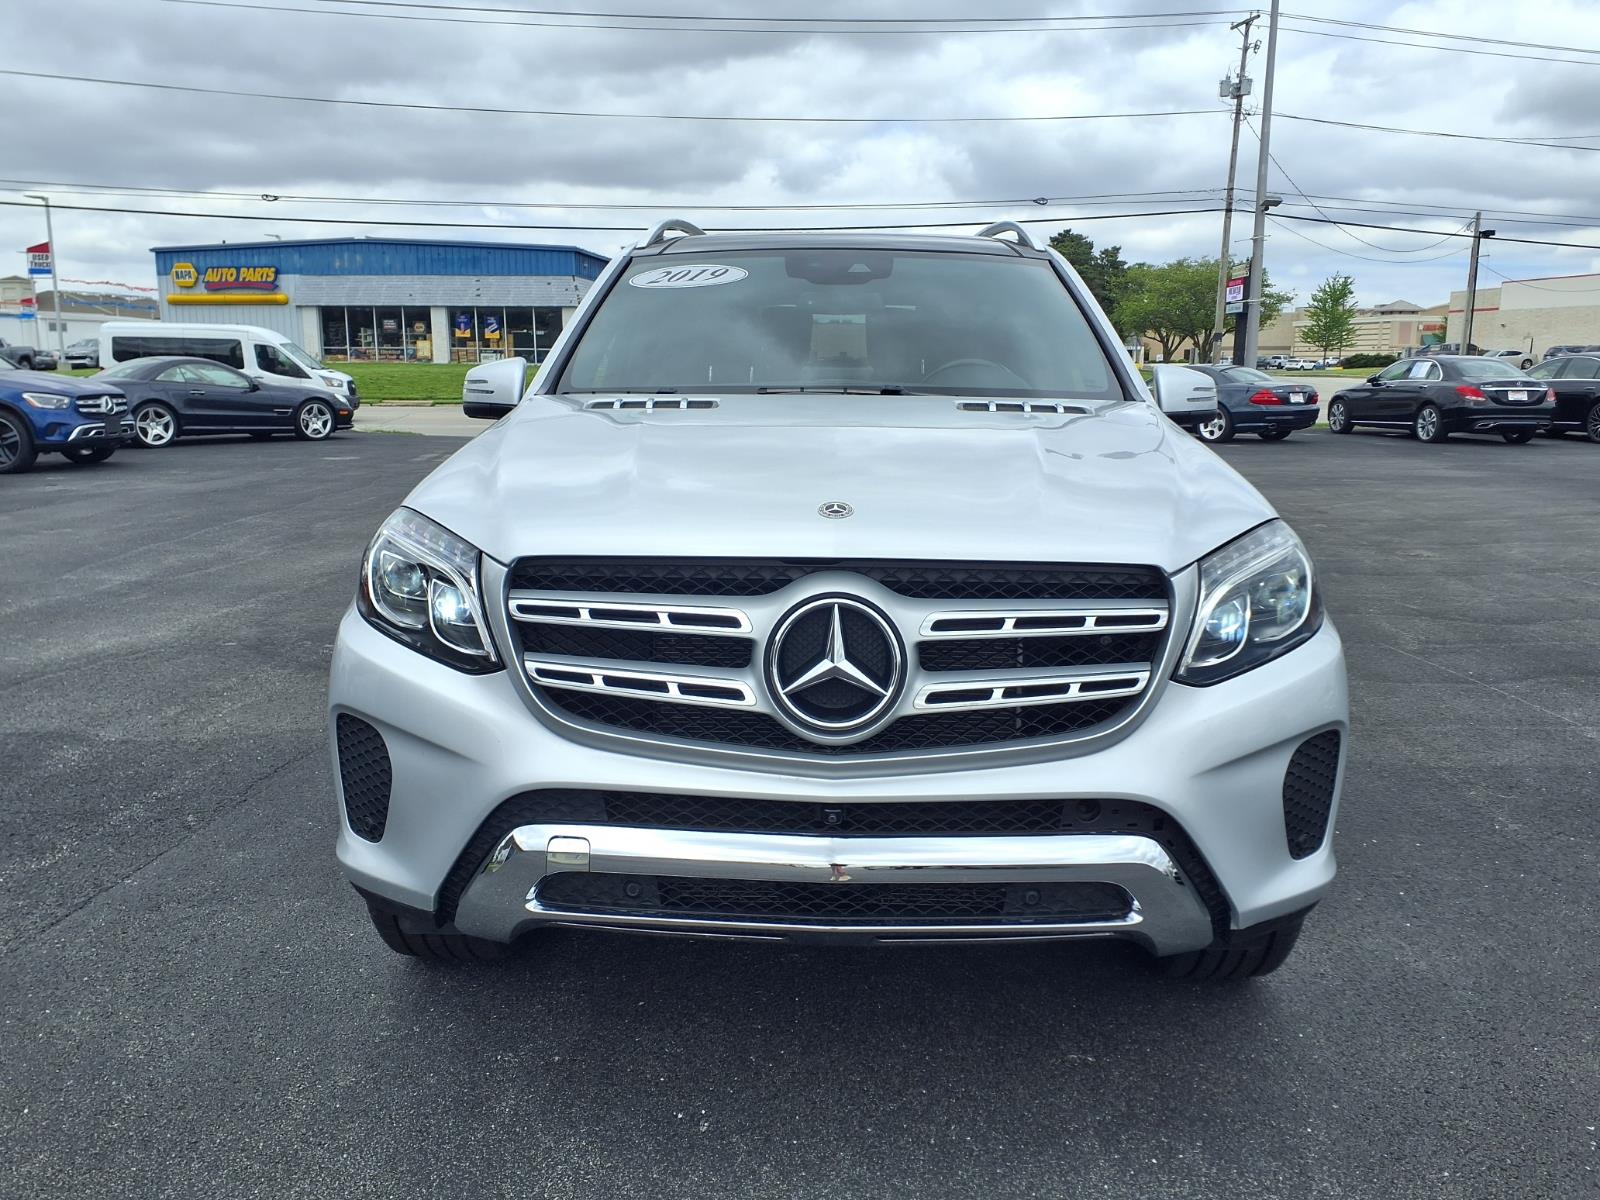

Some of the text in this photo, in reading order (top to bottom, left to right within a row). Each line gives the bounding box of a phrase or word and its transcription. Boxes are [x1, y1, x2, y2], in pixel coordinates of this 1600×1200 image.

[32, 253, 49, 261] USED
[174, 267, 276, 282] NAPA AUTO PARTS
[646, 268, 729, 284] 2019
